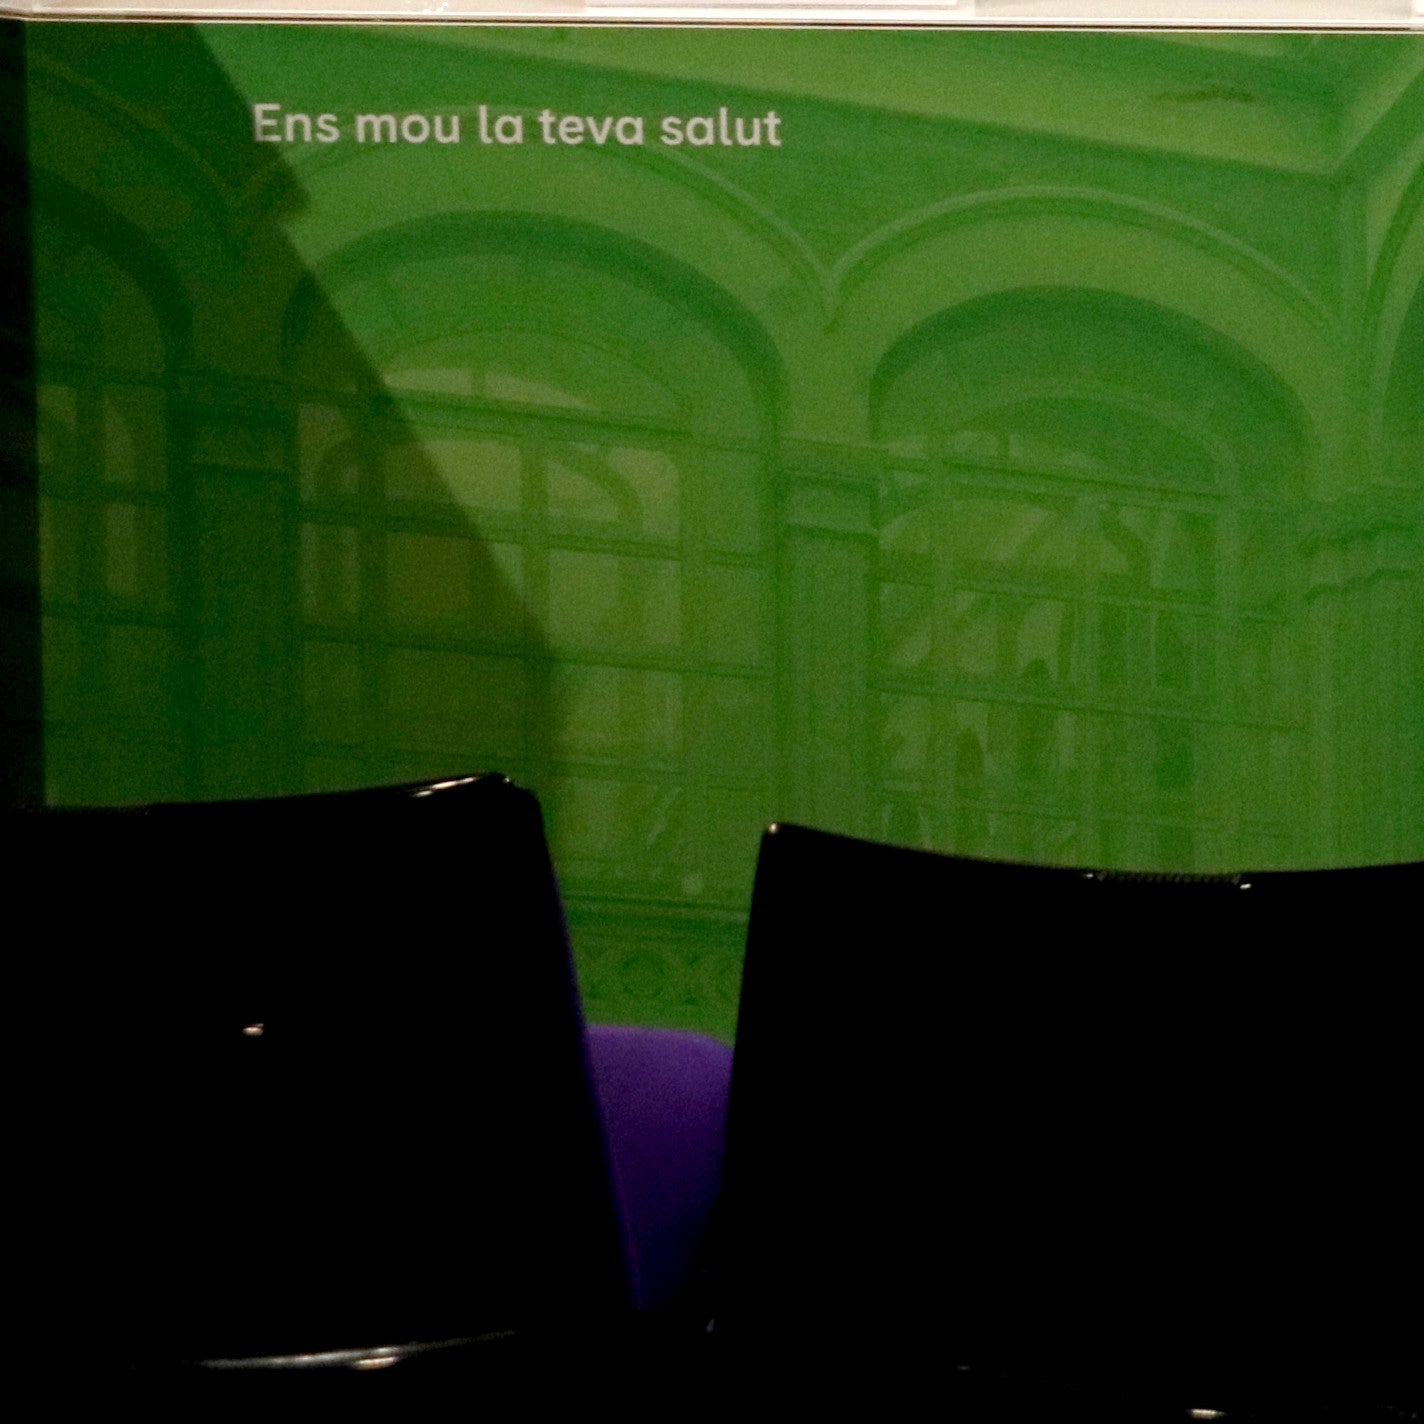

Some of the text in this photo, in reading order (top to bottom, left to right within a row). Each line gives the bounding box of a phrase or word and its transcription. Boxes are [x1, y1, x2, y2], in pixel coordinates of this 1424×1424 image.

[253, 103, 781, 146] Ens mou la teva salut
